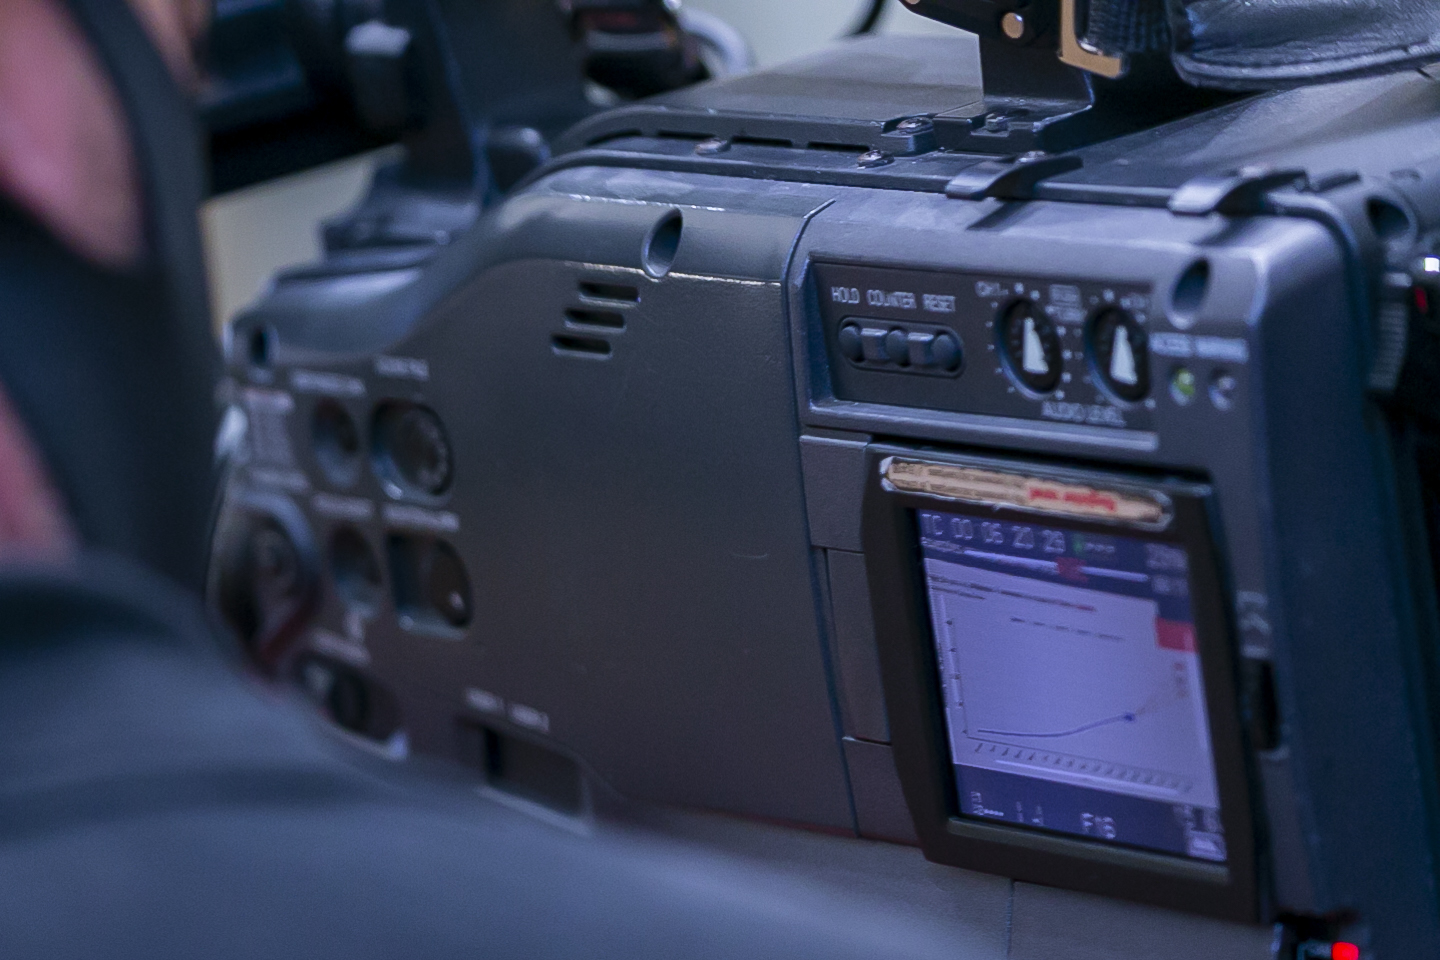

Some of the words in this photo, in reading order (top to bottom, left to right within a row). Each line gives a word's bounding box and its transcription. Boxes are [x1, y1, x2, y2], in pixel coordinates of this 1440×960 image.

[831, 286, 860, 304] HOLD
[866, 289, 917, 309] COUNTER
[922, 293, 956, 313] RESET
